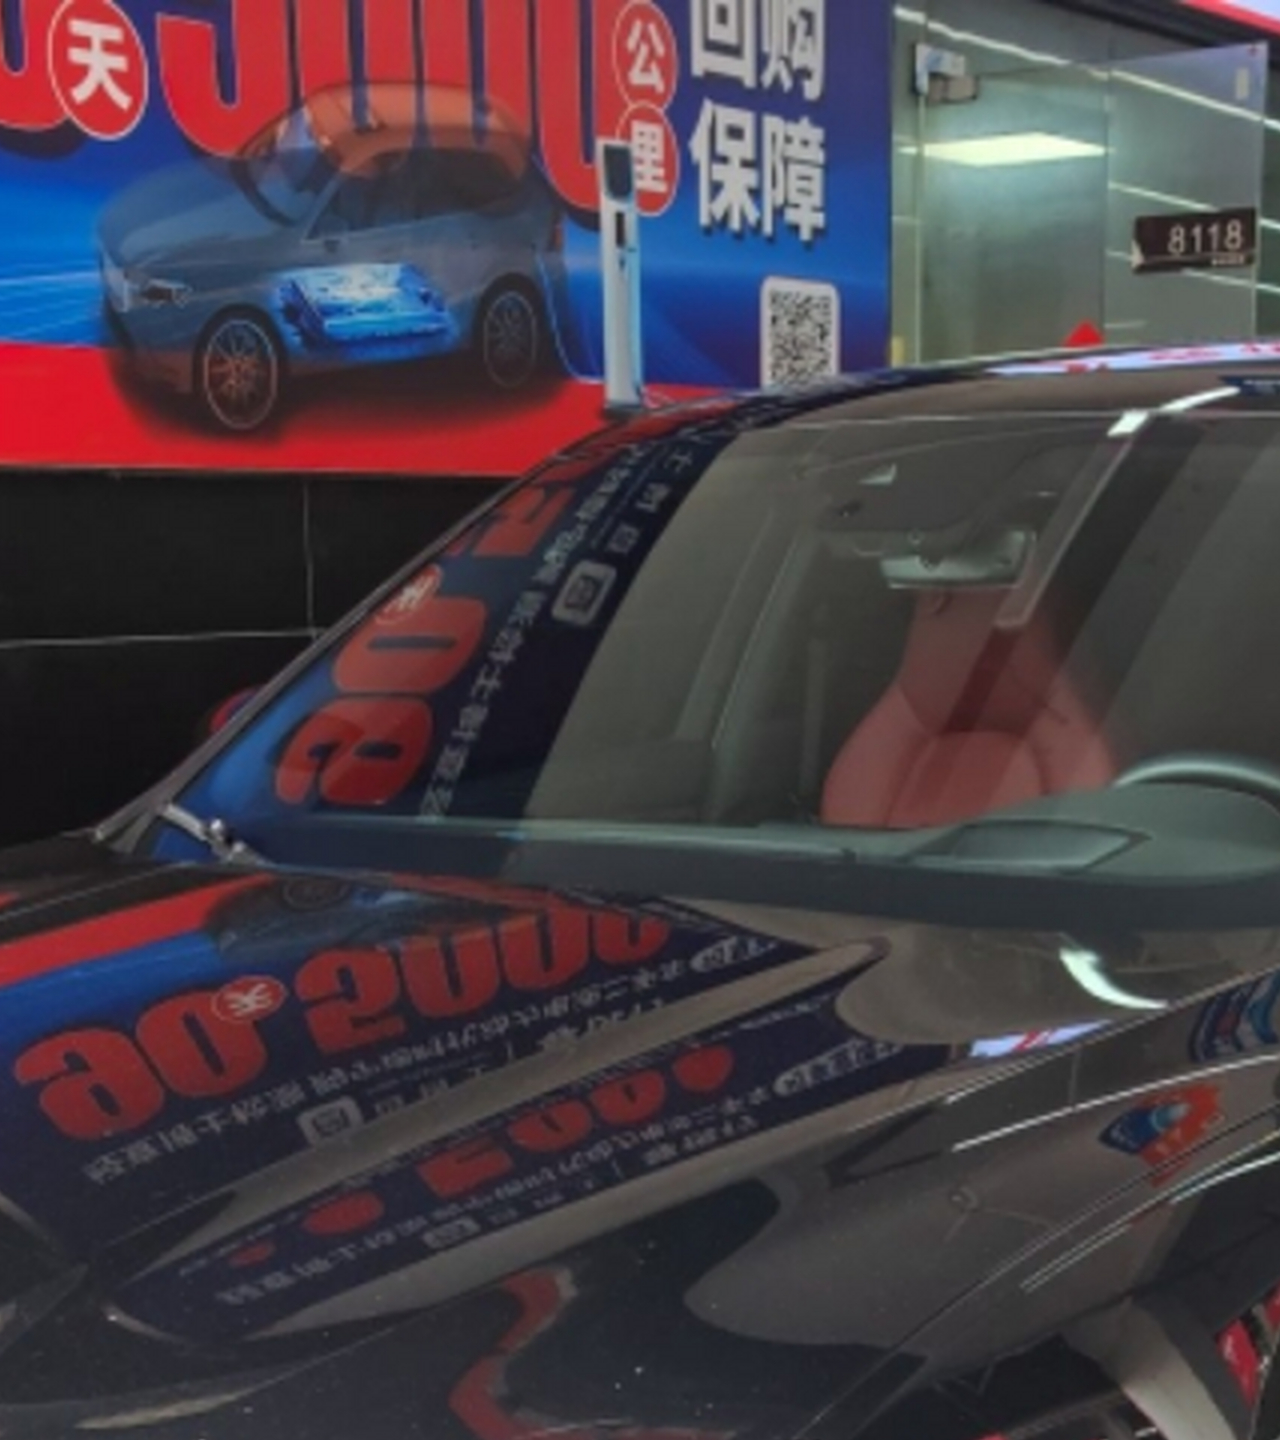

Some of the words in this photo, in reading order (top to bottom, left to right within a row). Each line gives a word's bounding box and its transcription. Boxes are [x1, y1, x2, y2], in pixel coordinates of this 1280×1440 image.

[690, 0, 825, 101] 回购
[688, 97, 825, 242] 保障
[1167, 219, 1244, 256] 8118
